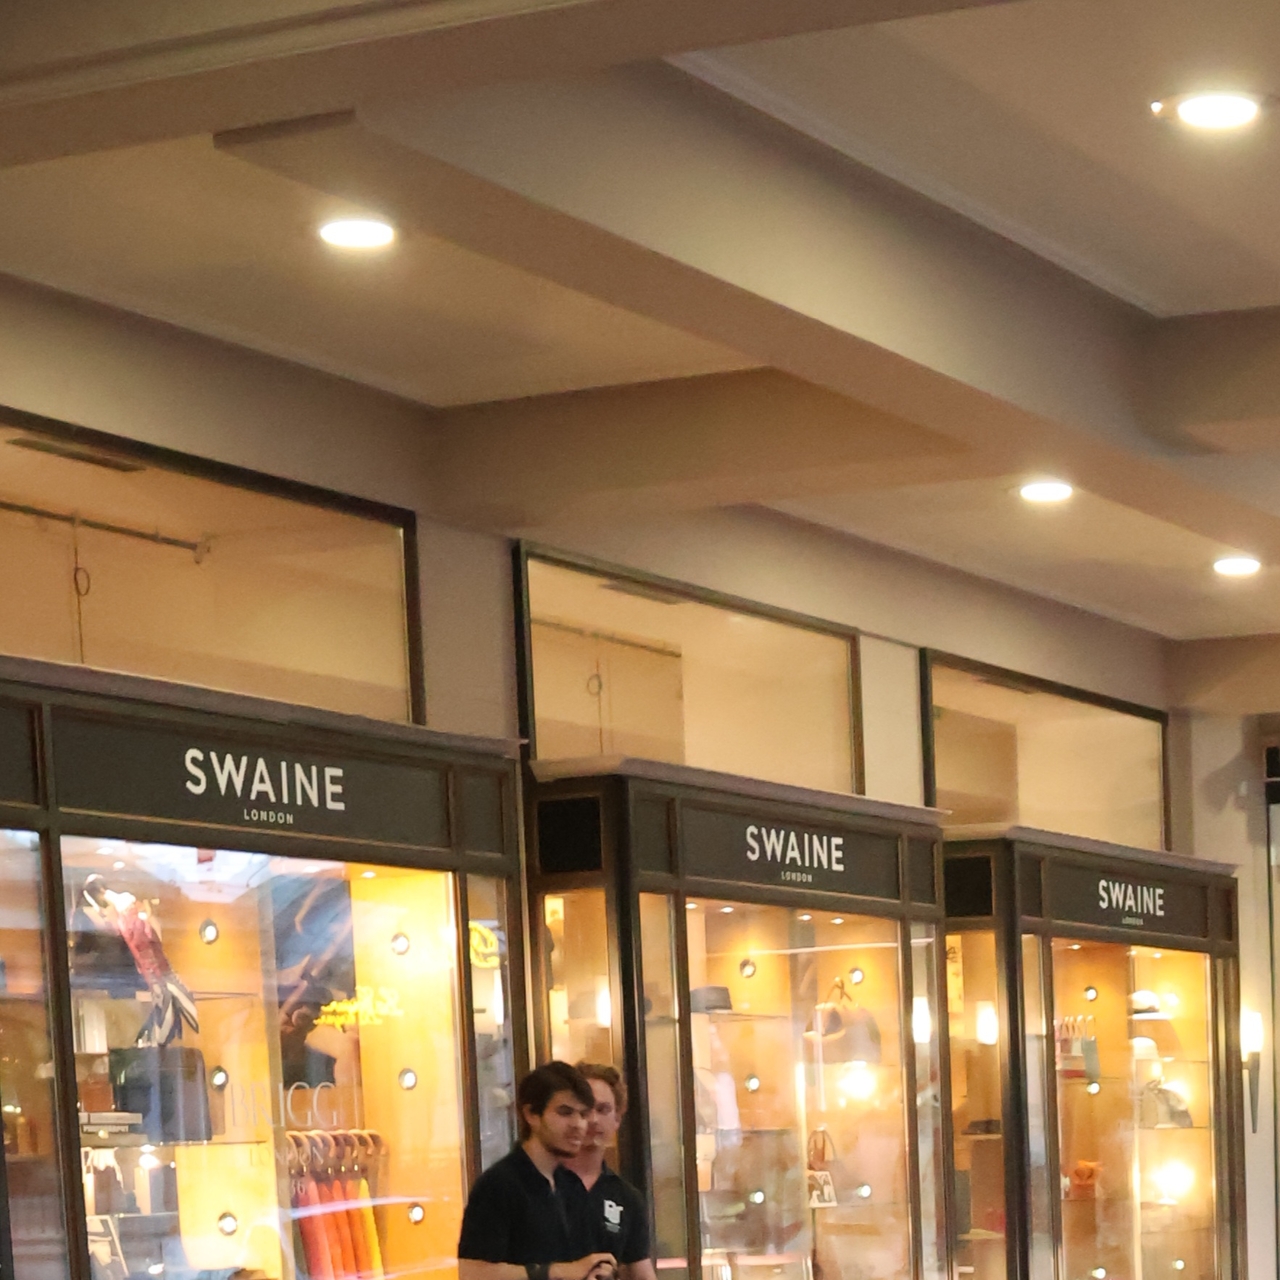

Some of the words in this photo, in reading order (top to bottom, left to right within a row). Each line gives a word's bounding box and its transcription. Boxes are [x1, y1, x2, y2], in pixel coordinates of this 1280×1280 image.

[184, 748, 346, 811] SWAINE
[243, 808, 294, 824] LONDON
[745, 825, 845, 872] SWAINE
[781, 871, 813, 882] LONDON
[1098, 879, 1165, 916] SWAINE
